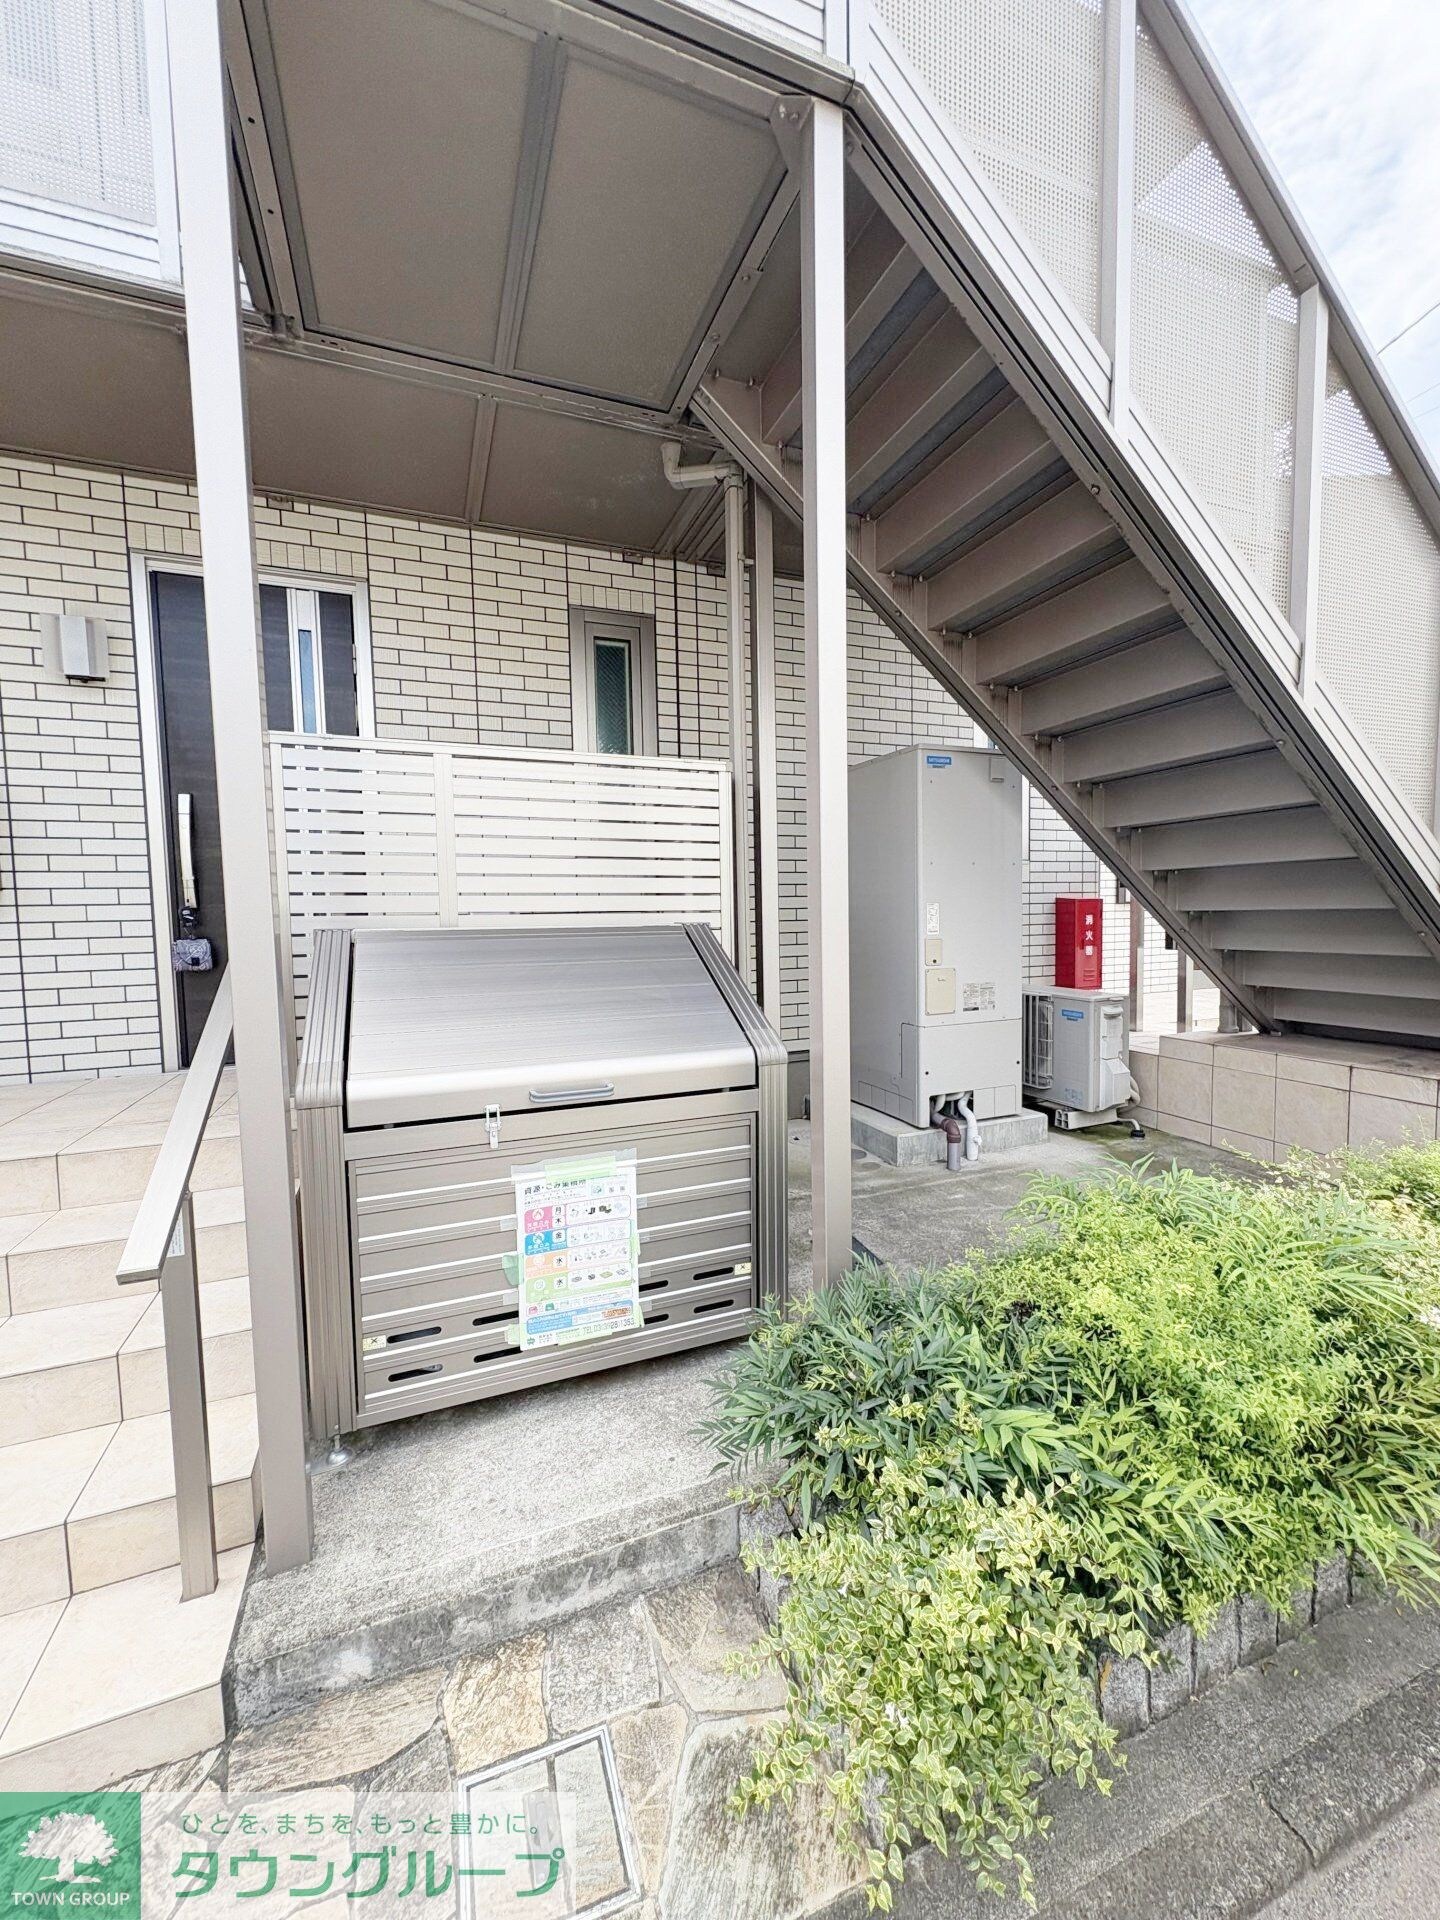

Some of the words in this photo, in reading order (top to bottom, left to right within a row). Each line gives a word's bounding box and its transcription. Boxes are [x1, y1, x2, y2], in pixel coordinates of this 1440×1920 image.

[1085, 914, 1094, 956] 消火器
[556, 1278, 564, 1286] 水
